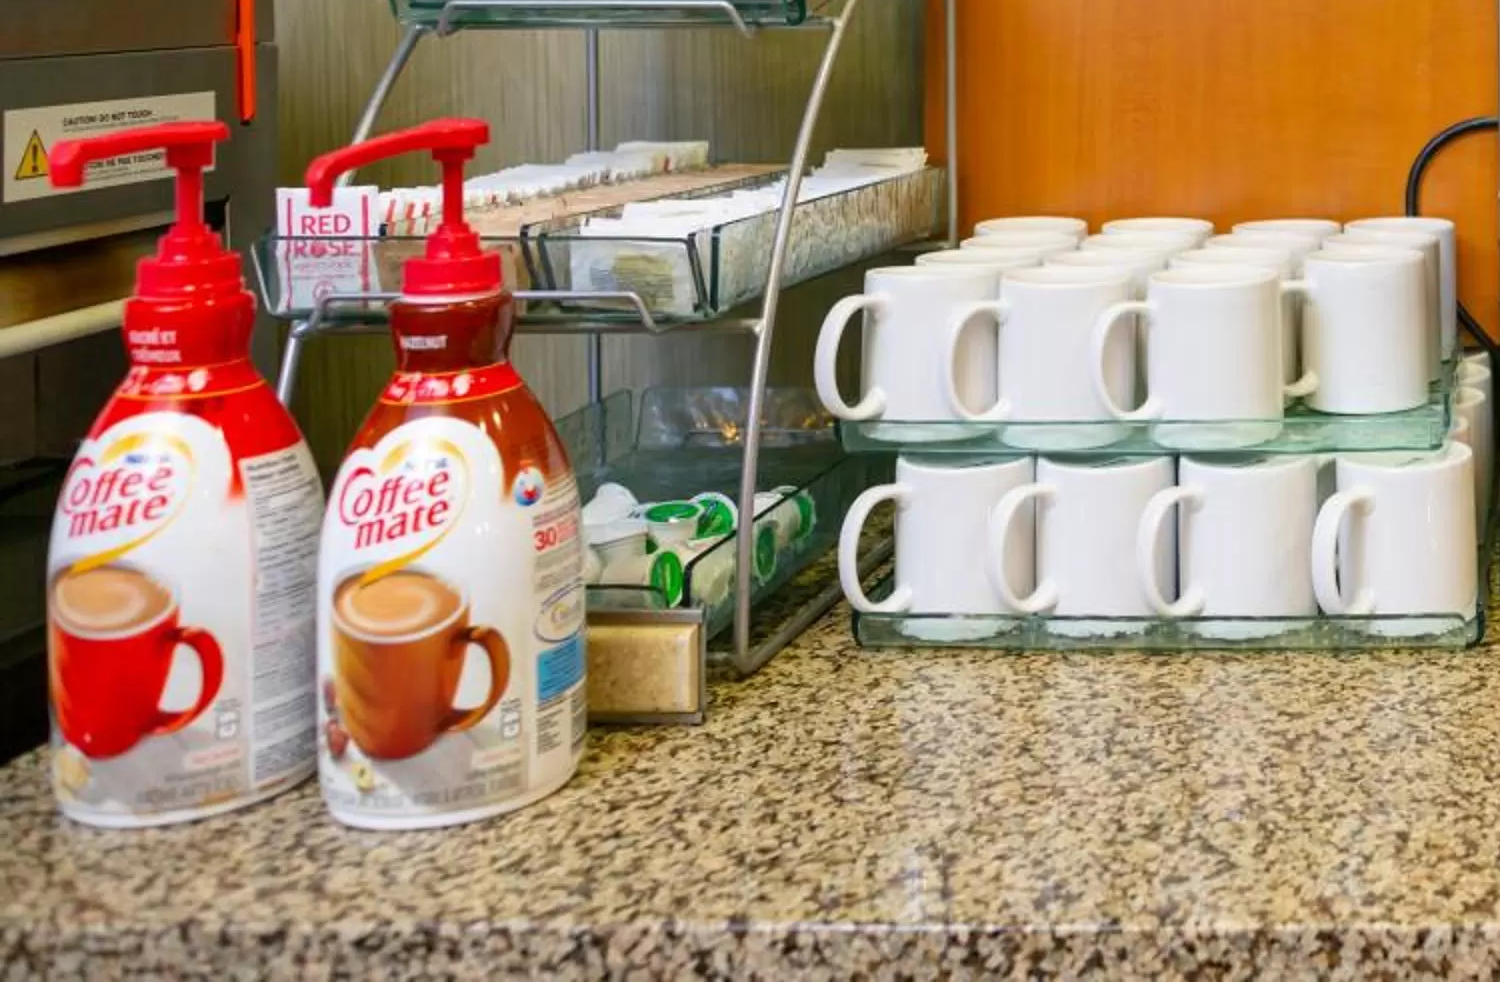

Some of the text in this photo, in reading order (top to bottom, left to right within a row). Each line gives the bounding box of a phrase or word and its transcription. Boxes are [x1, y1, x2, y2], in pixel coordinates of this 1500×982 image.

[301, 214, 351, 235] RED
[61, 456, 173, 514] Coffee
[339, 465, 450, 527] Coffee
[69, 495, 168, 538] mate
[354, 499, 449, 550] mate
[533, 527, 557, 551] 30
